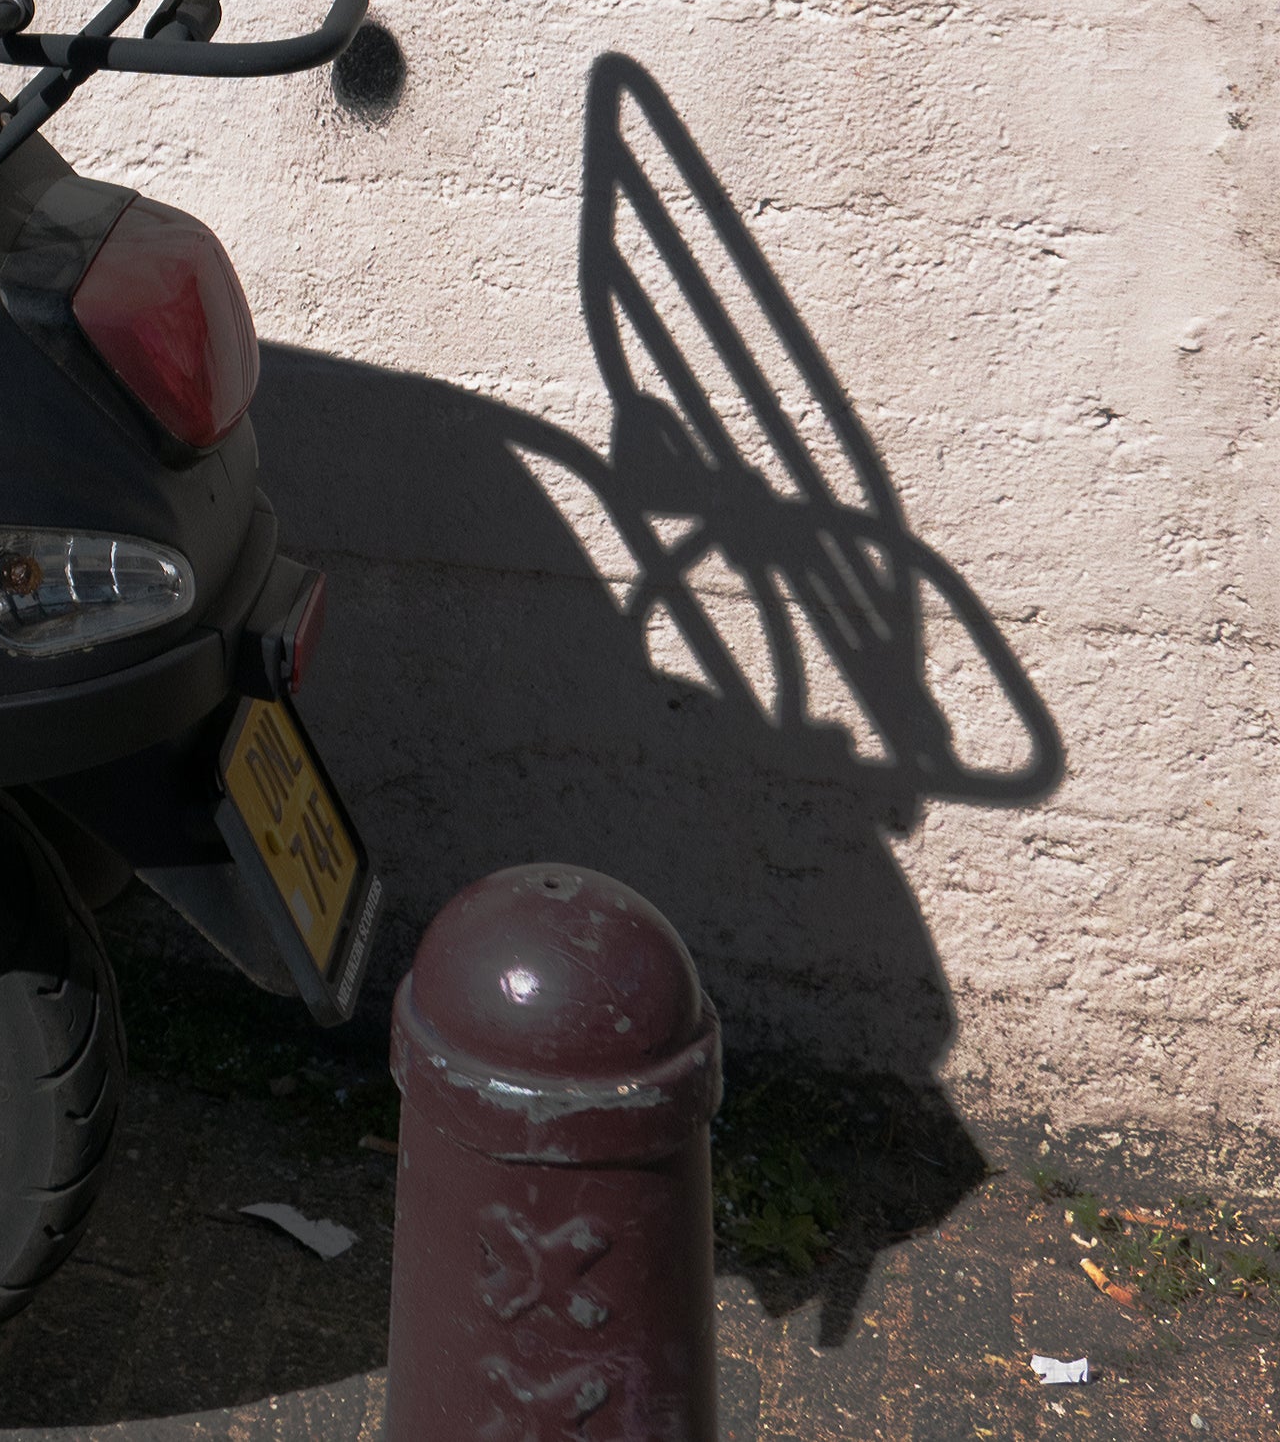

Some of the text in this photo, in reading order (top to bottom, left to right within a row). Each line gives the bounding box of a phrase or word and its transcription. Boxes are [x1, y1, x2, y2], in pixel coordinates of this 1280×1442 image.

[244, 706, 303, 825] DNL
[289, 790, 344, 916] 74F
[358, 874, 384, 942] SCOOTERS
